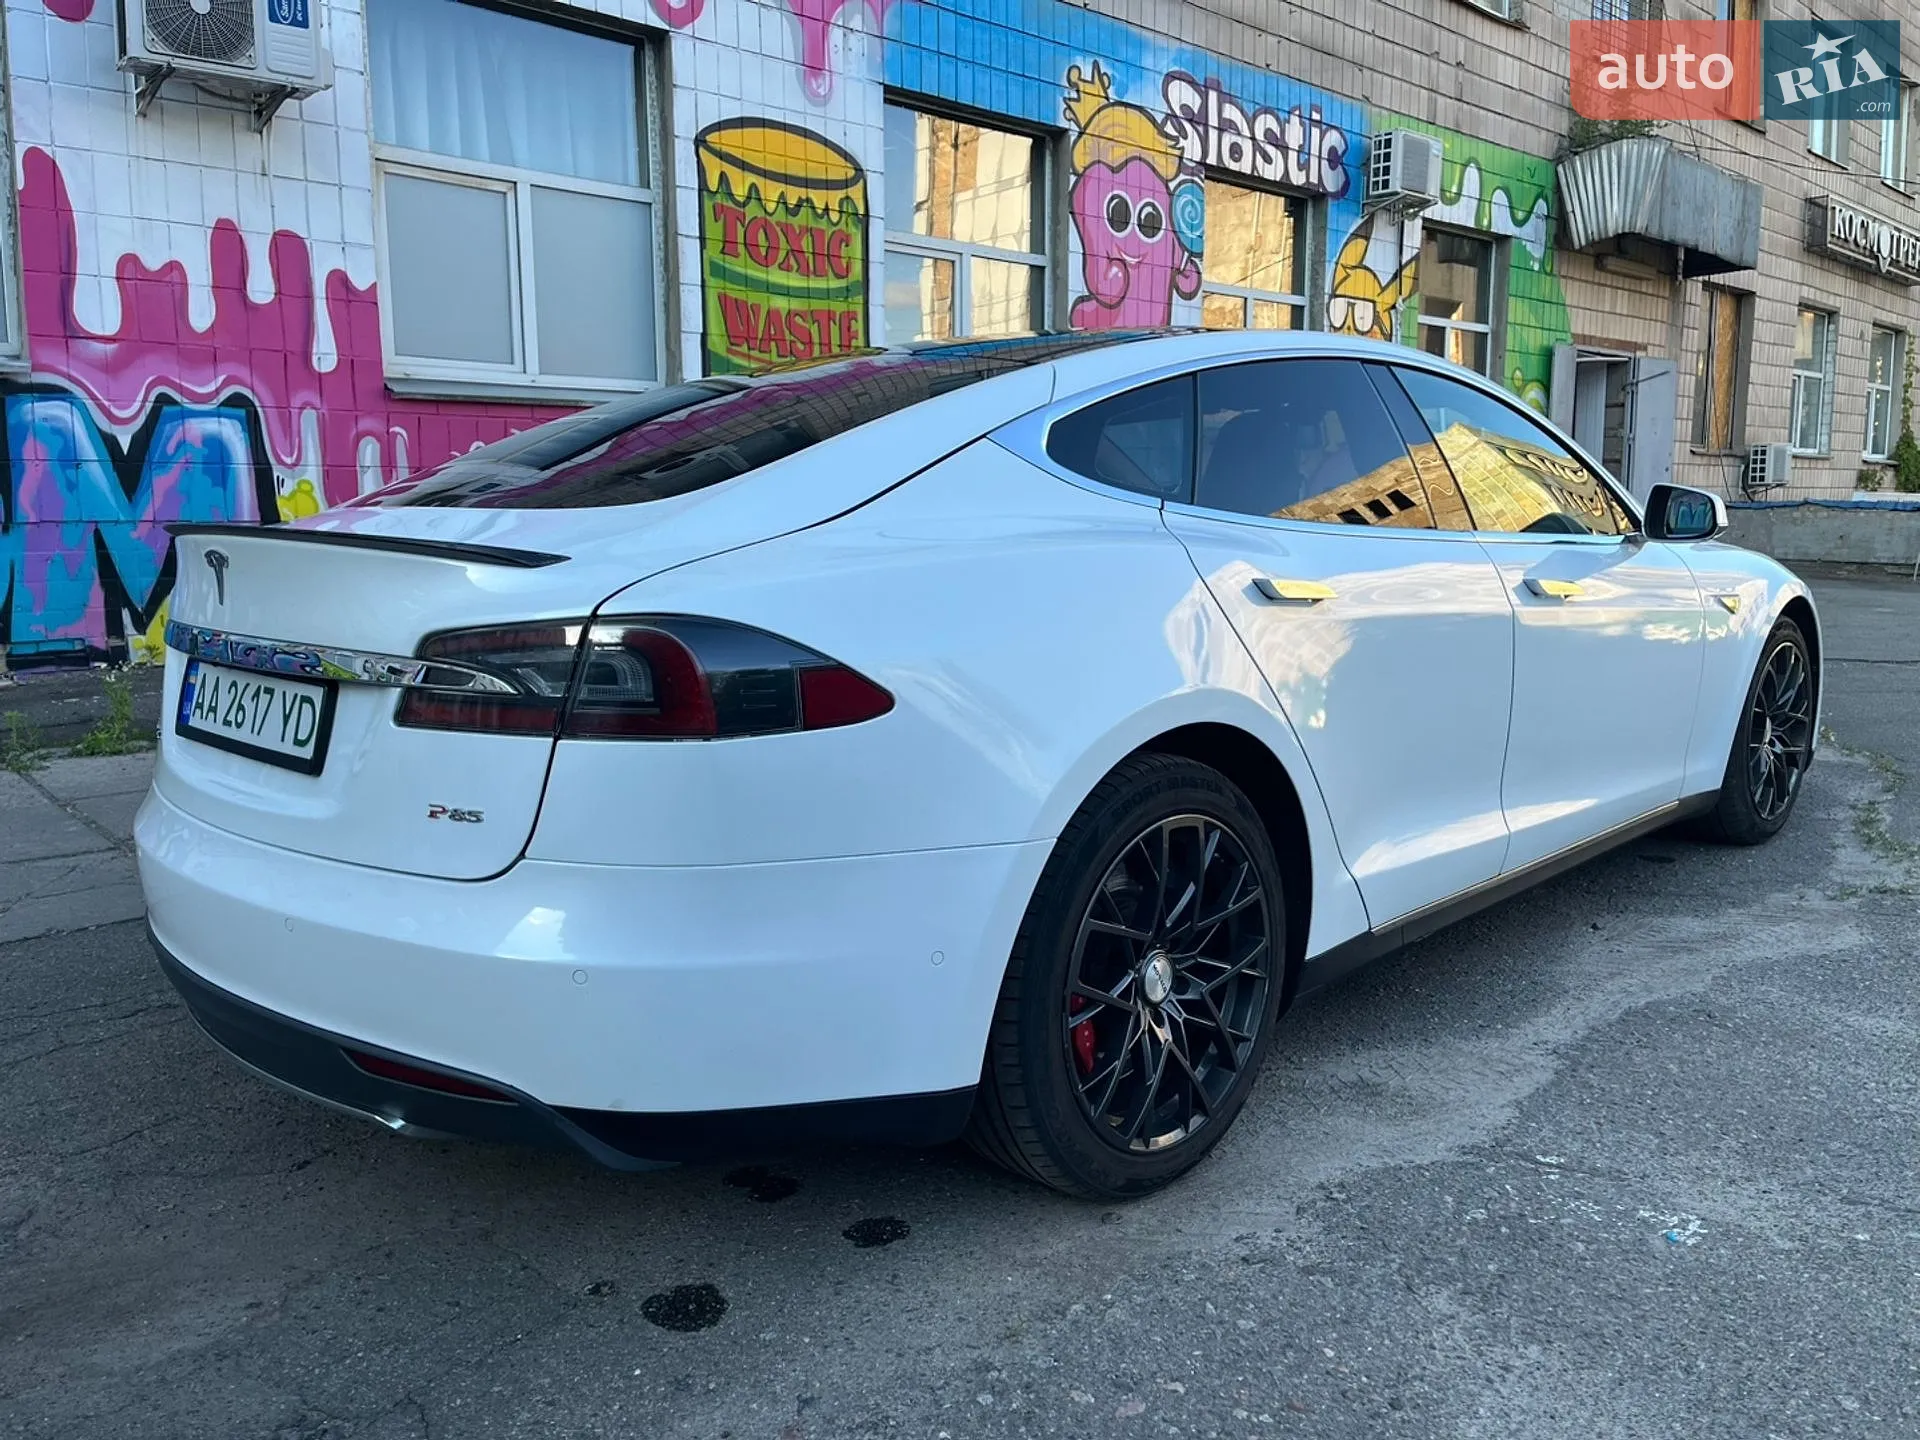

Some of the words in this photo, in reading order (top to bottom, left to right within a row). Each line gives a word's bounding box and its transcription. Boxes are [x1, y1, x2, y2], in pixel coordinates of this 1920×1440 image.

[1163, 71, 1349, 197] Slastic
[713, 202, 853, 279] TOXIC
[193, 672, 220, 723] AA
[222, 680, 276, 736] 2617
[281, 690, 316, 748] YD
[427, 803, 485, 823] P85
